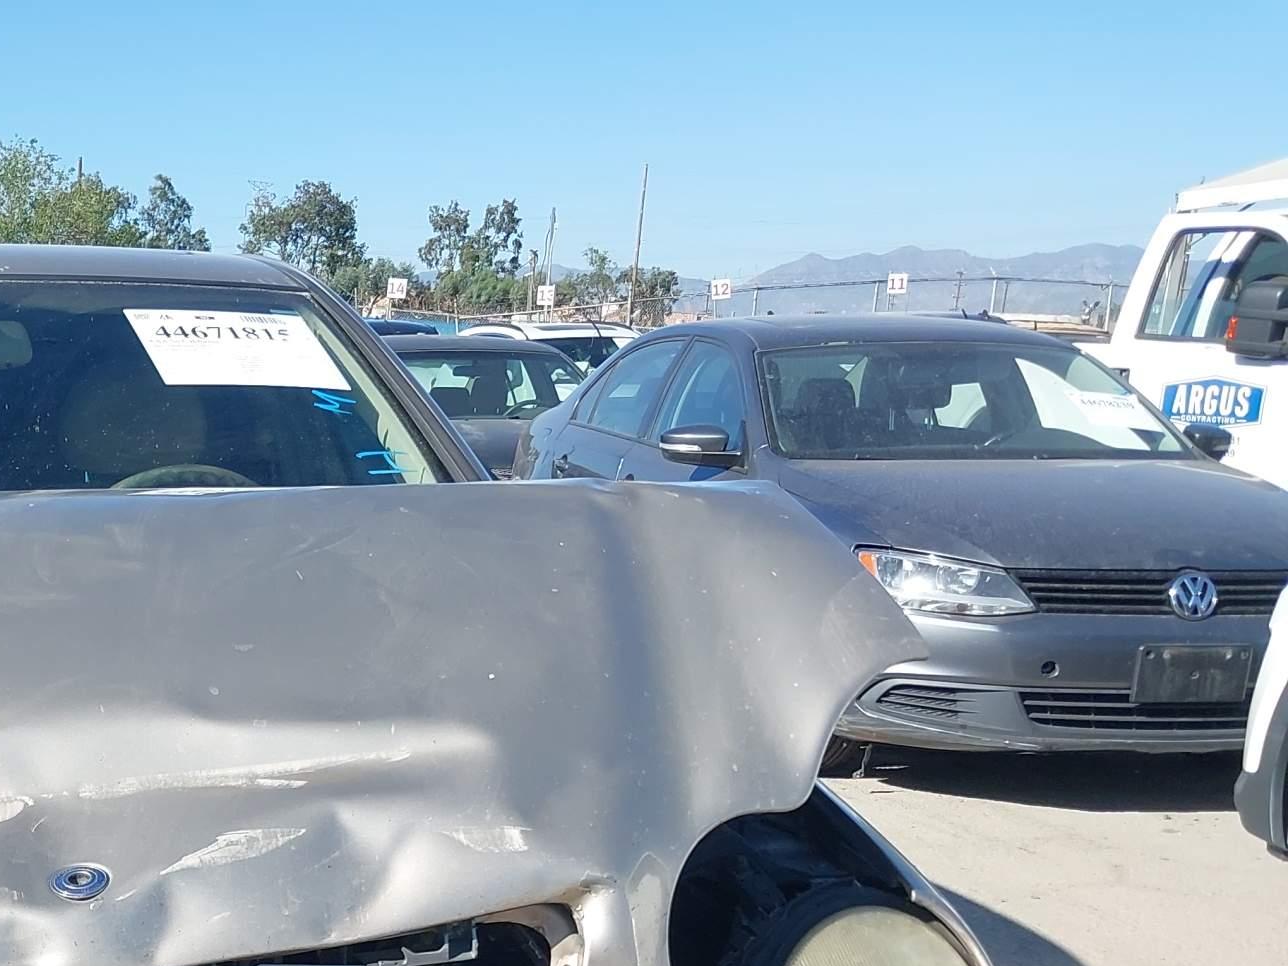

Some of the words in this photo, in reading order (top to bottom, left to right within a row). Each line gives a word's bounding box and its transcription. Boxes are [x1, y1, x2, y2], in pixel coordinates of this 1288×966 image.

[388, 282, 404, 295] 14
[712, 283, 729, 296] 12
[889, 278, 905, 290] 11
[155, 325, 289, 342] 44671815
[1171, 384, 1252, 418] ARGUS
[1180, 414, 1237, 424] CONTRACTING
